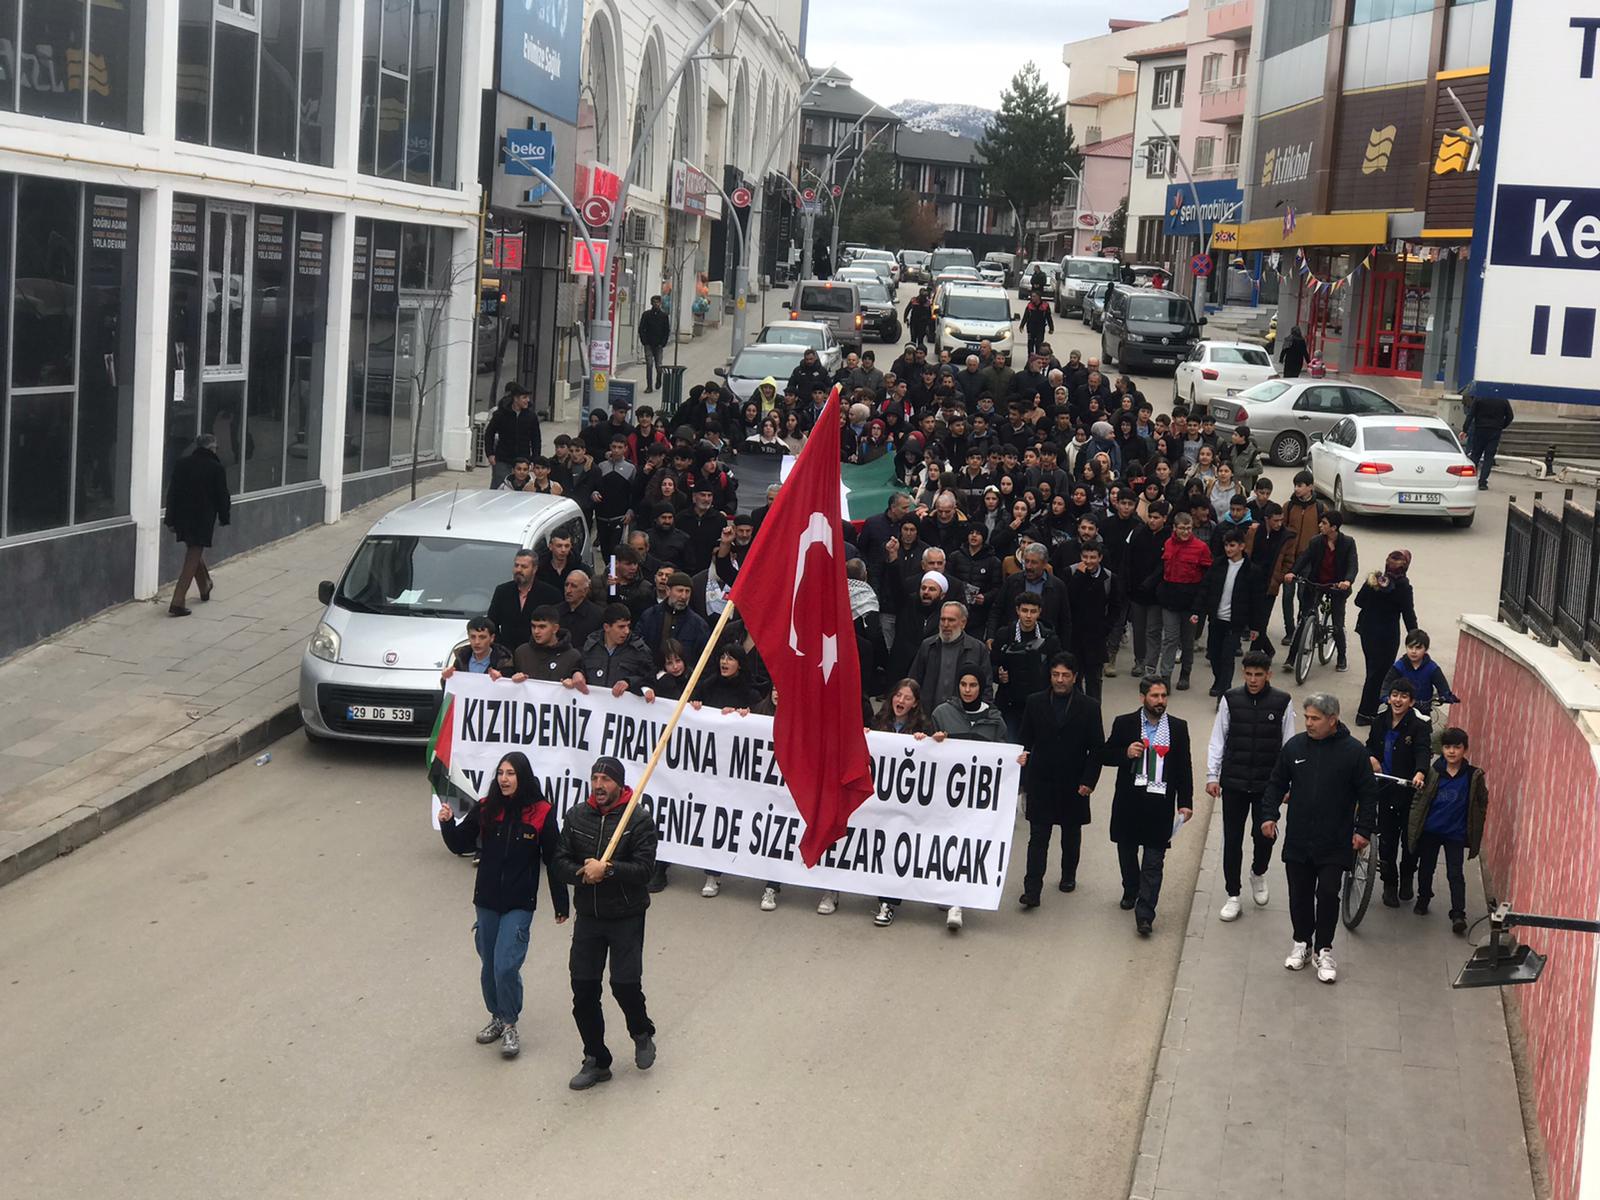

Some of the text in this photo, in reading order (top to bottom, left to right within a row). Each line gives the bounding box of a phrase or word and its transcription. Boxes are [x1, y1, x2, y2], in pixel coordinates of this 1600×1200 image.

[511, 141, 546, 156] beko
[1272, 141, 1313, 185] istikbal
[354, 707, 411, 720] 29 DG 539
[461, 697, 592, 751] KIZILDENİZ
[729, 735, 785, 787] MEZ
[946, 755, 1003, 812] GİBİ
[712, 805, 743, 853] DE
[749, 803, 800, 862] SİZE
[816, 827, 887, 875] EZAR
[894, 831, 993, 886] OLACAK
